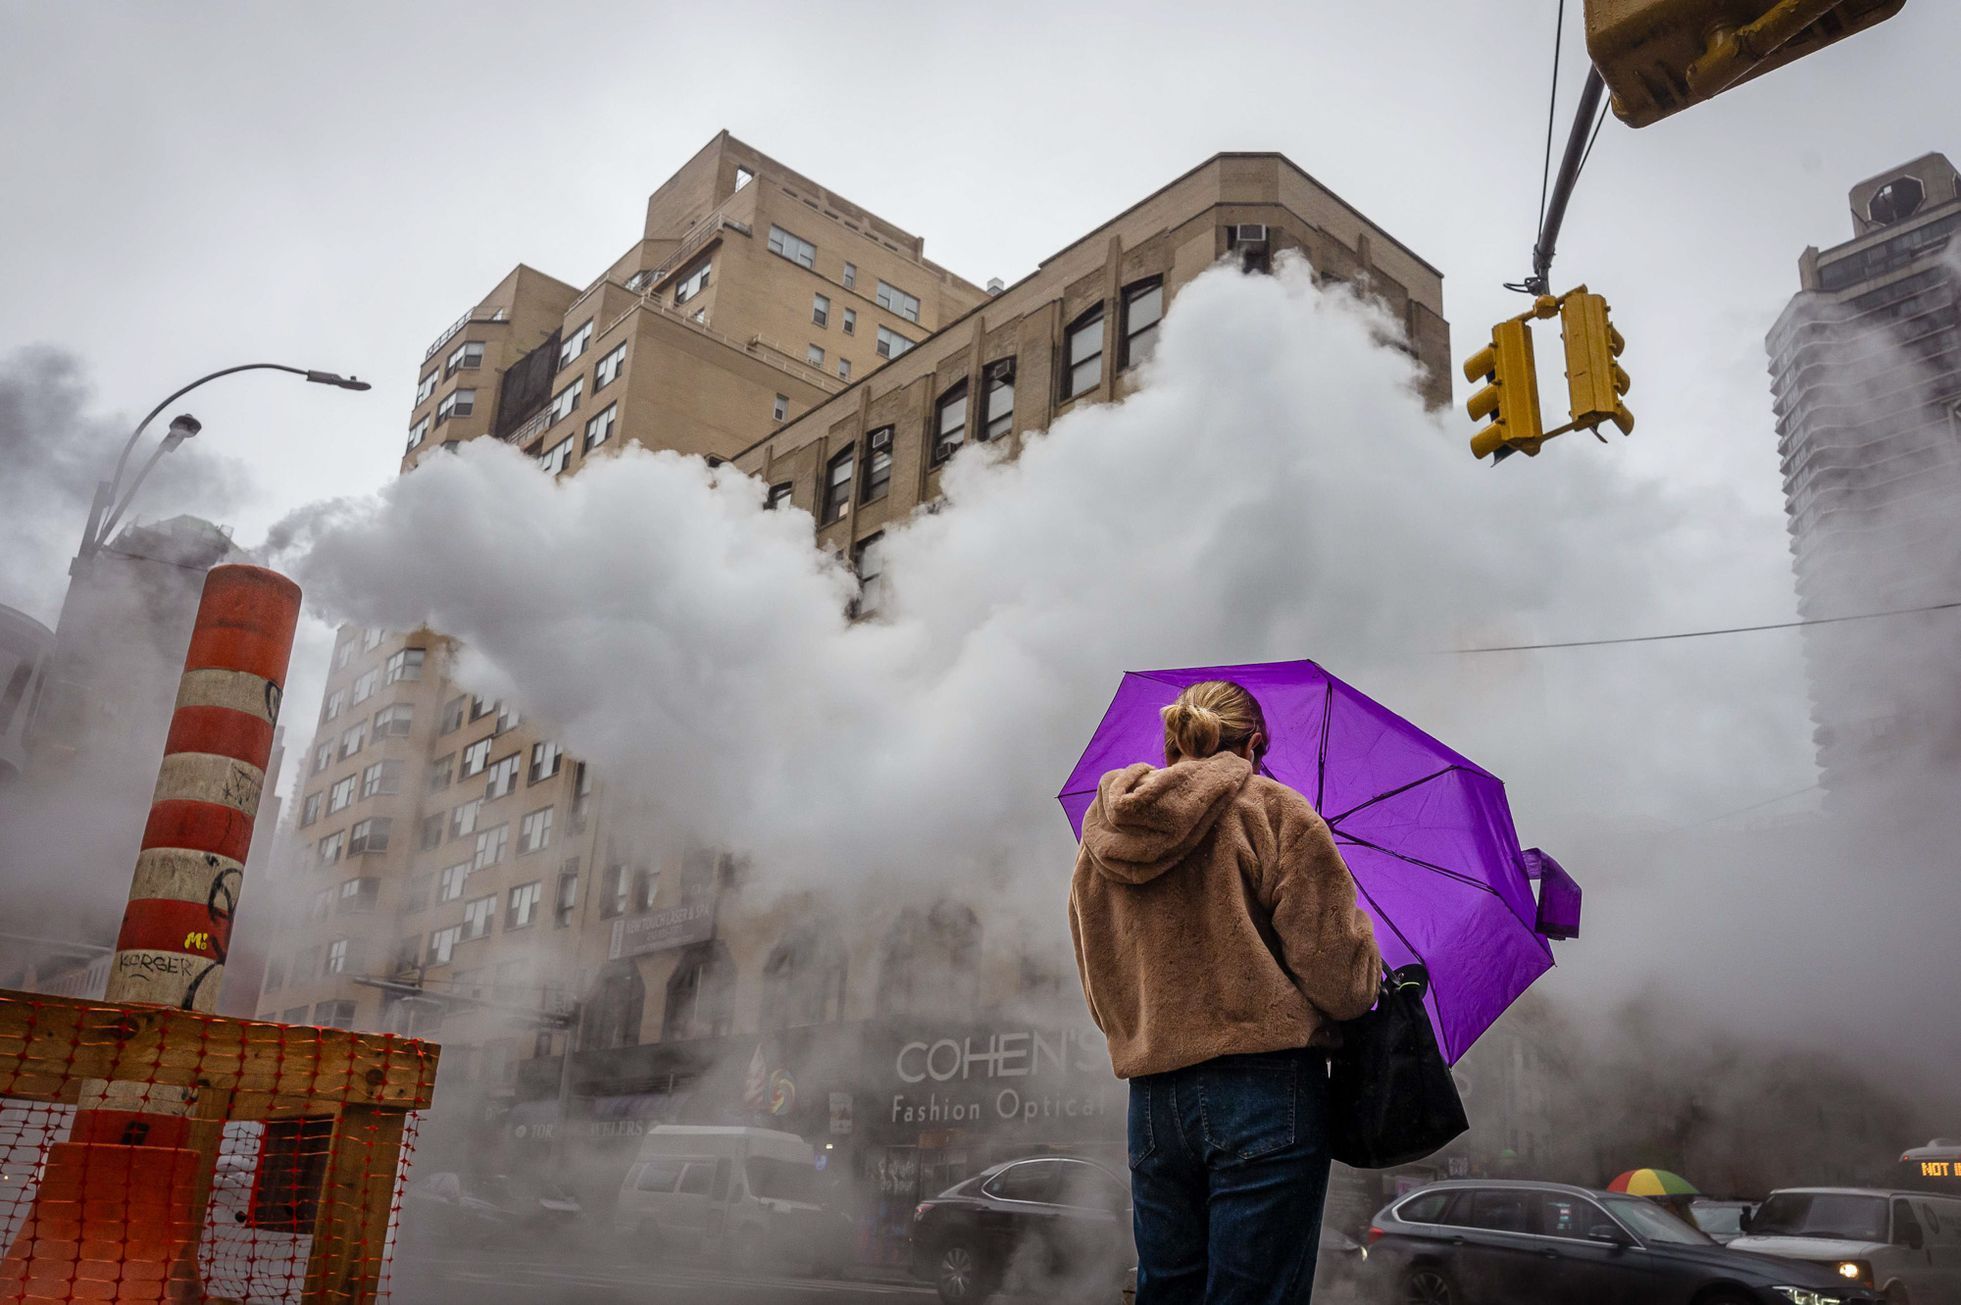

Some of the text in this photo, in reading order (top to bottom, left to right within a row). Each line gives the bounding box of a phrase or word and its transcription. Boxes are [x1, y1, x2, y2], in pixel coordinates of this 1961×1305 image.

[896, 1030, 1103, 1083] COHEN'S
[892, 1088, 1105, 1124] Fashion Optical
[1921, 1162, 1949, 1177] NOT
